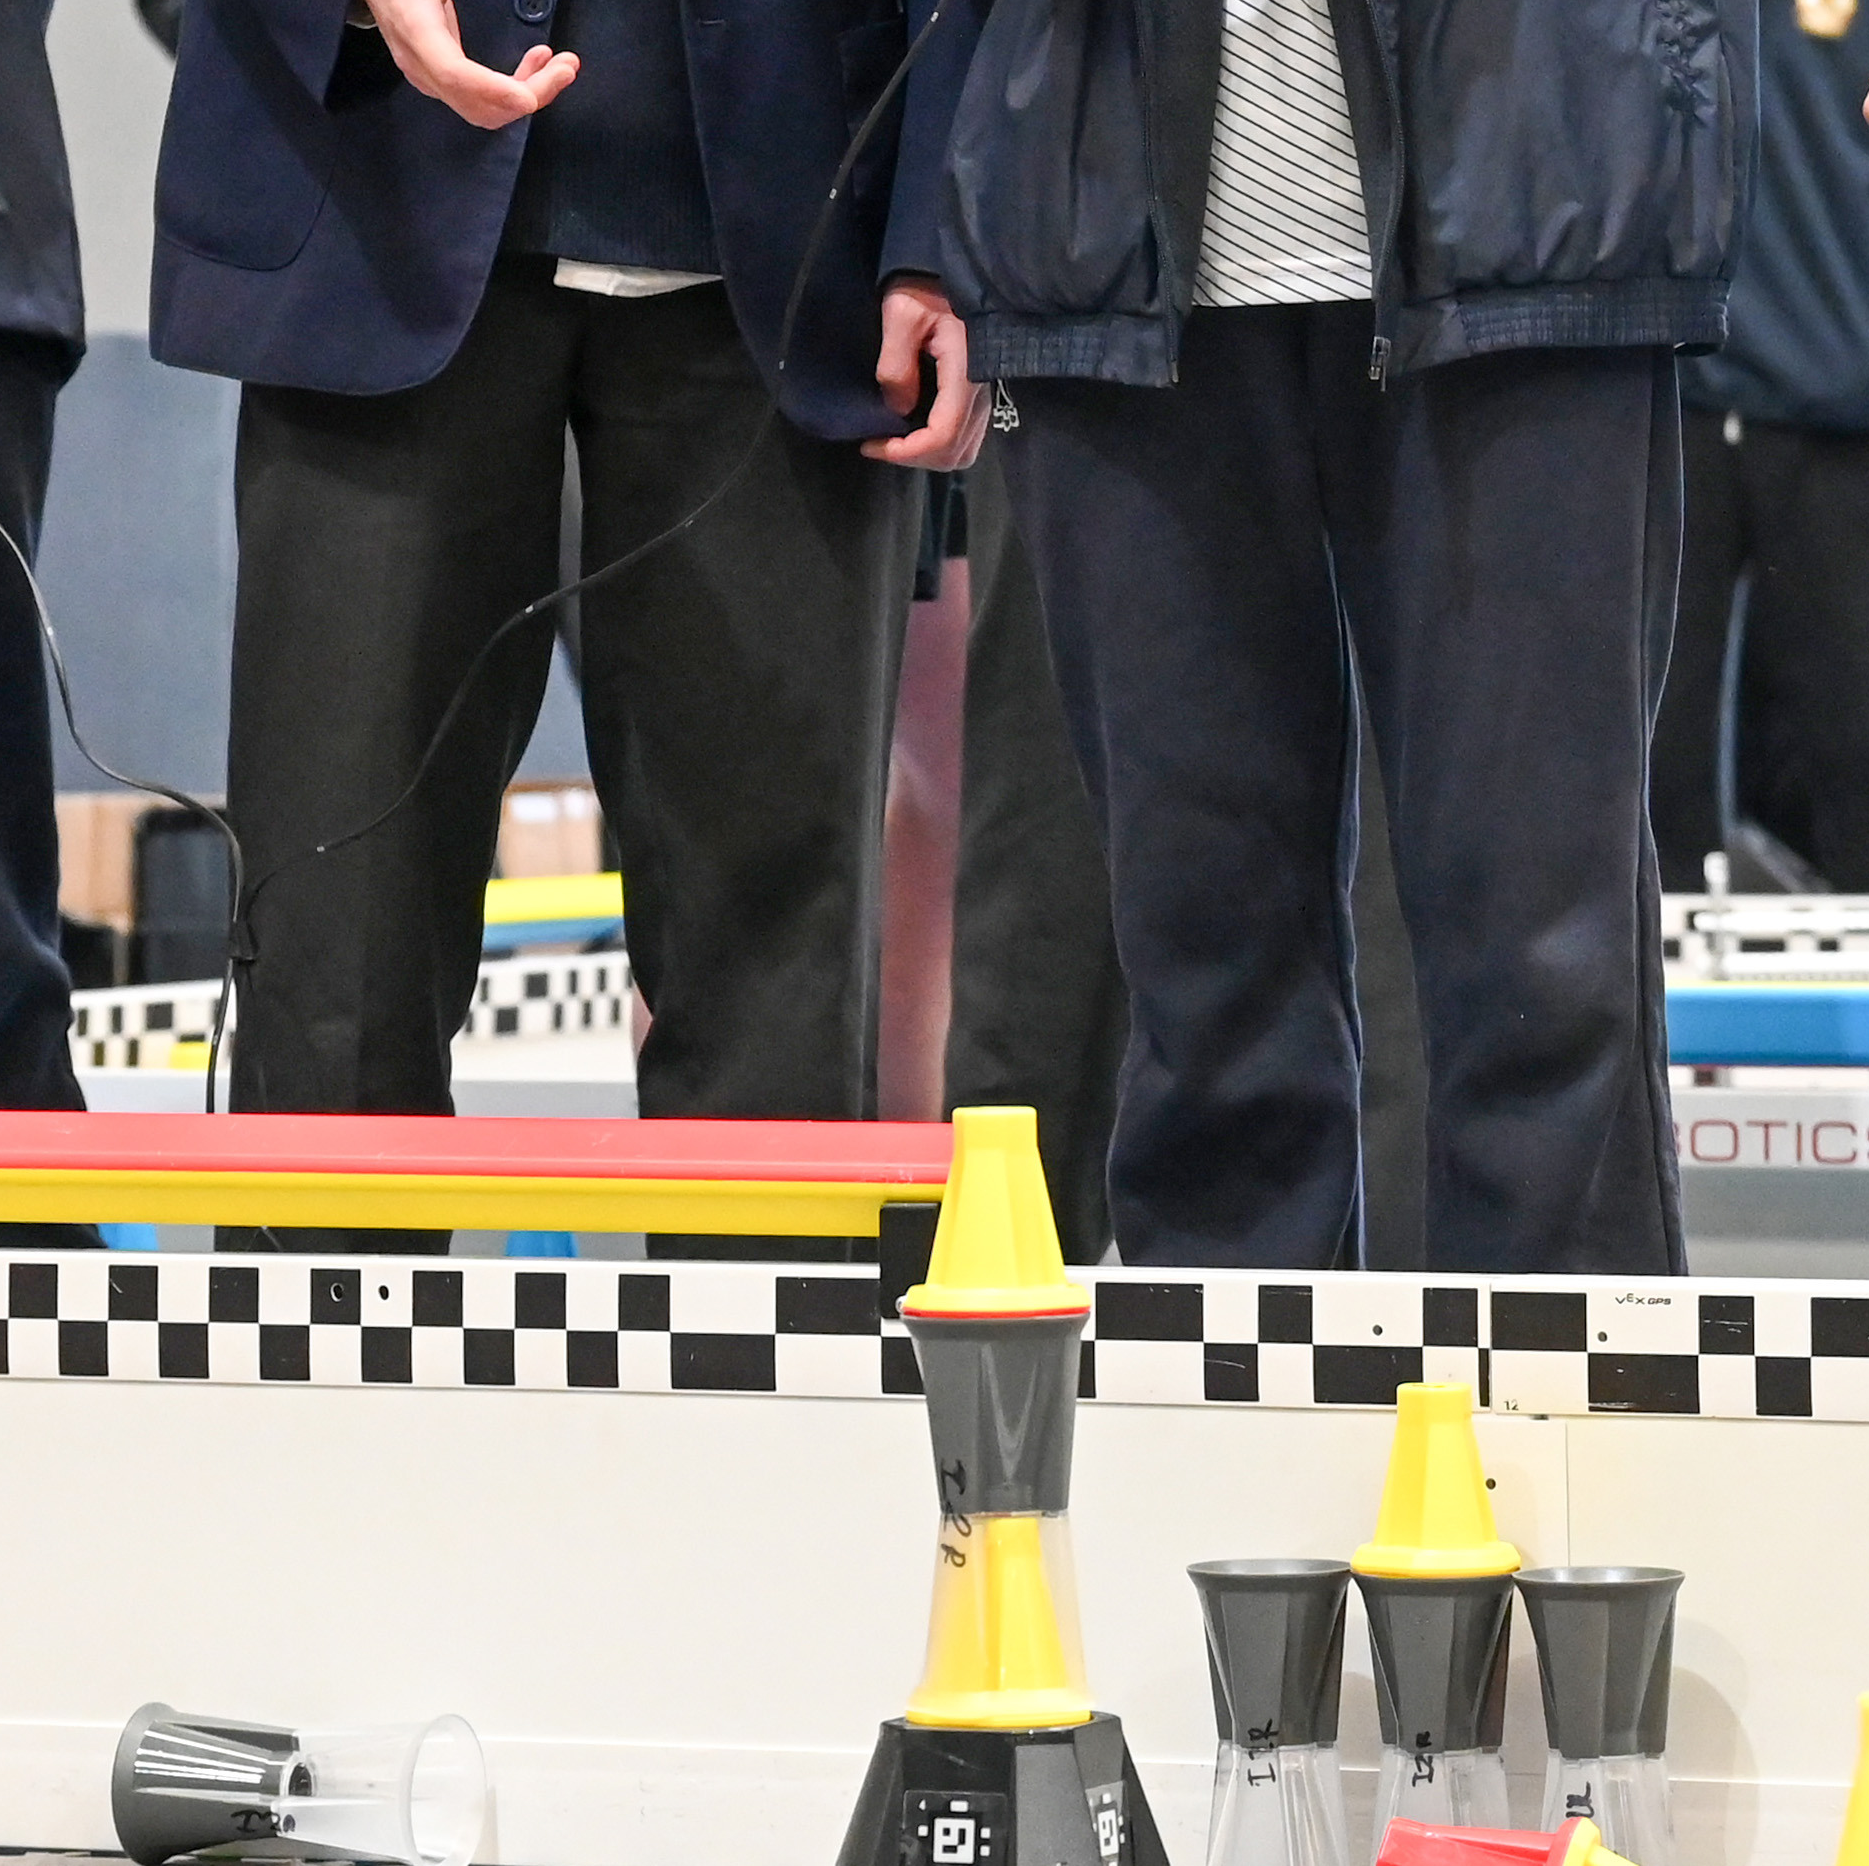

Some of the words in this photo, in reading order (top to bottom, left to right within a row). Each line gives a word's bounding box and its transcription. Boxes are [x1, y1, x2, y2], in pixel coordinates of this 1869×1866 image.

[1615, 1293, 1645, 1305] VEX
[1647, 1297, 1671, 1305] GPS
[1504, 1399, 1519, 1411] 12
